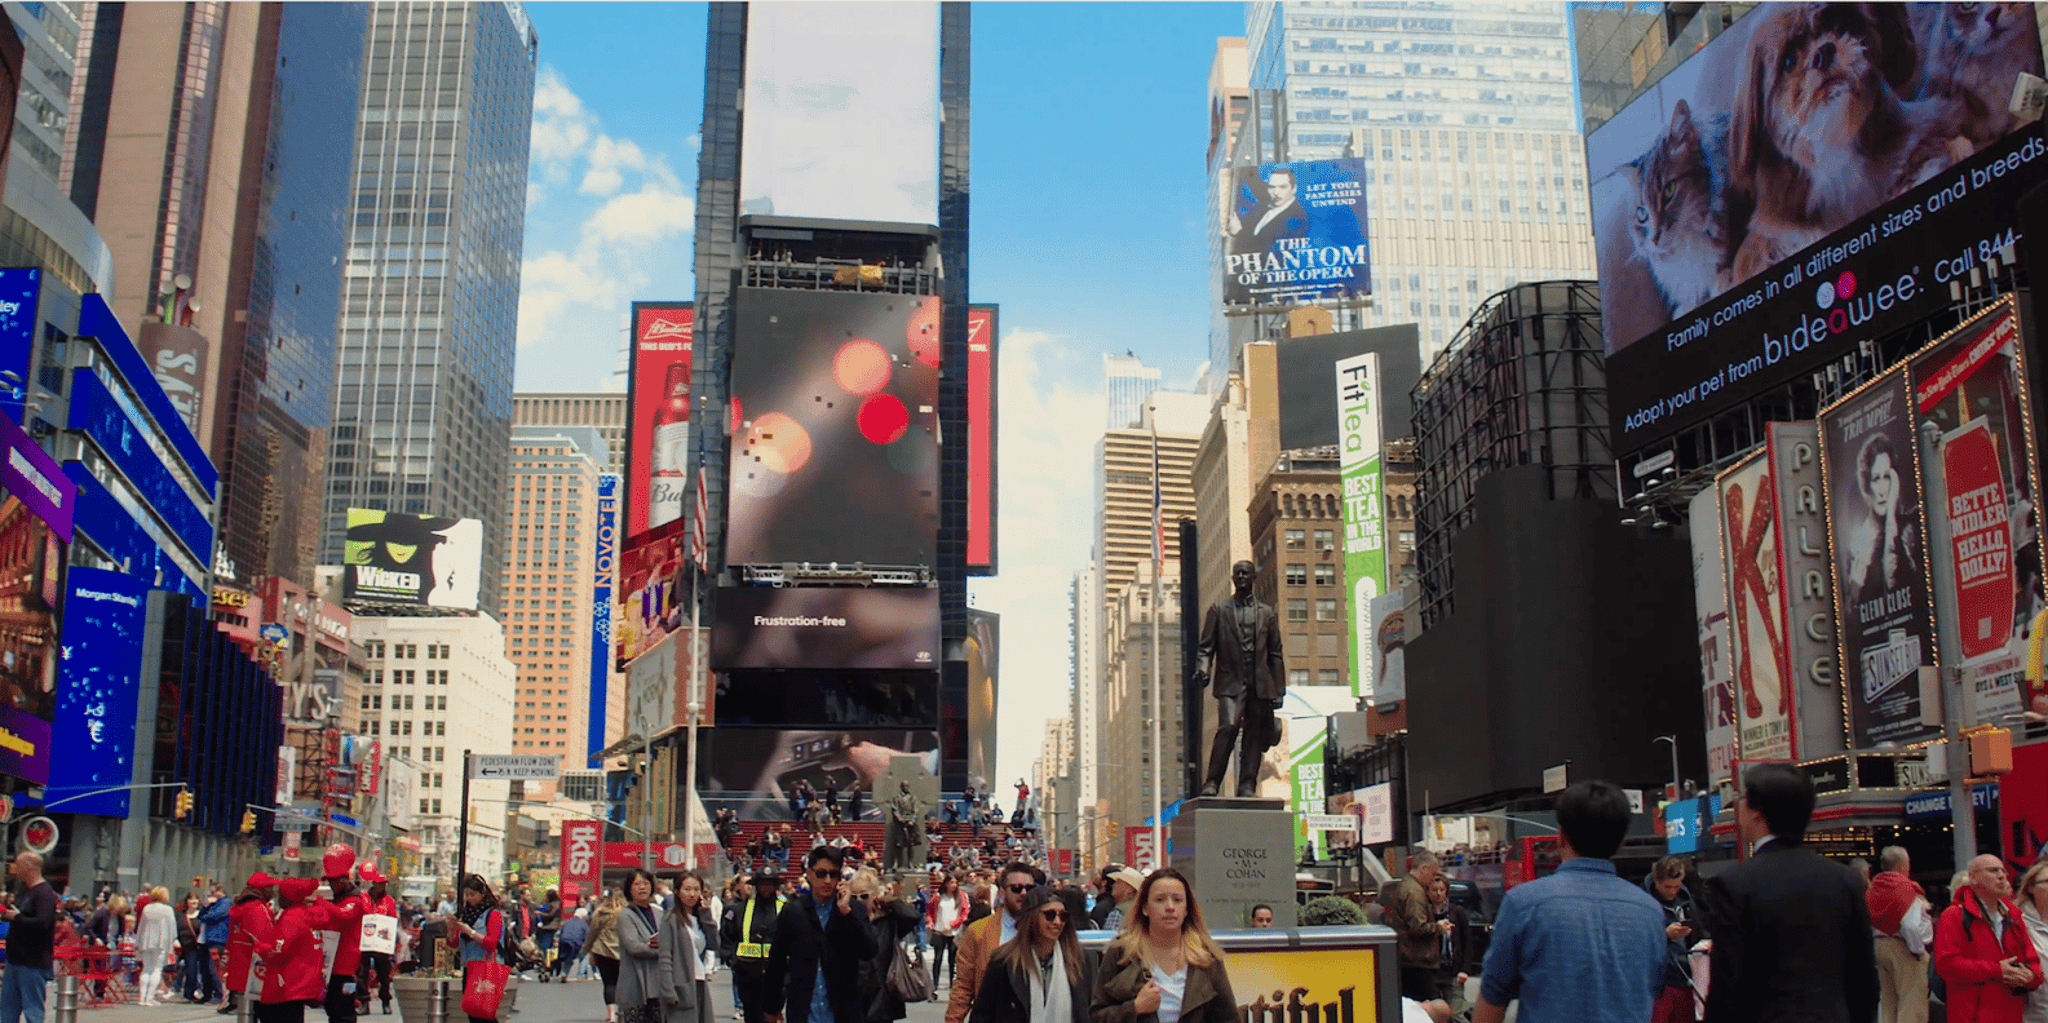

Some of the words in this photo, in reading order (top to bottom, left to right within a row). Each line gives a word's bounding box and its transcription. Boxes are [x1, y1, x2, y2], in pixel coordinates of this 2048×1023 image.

[1305, 189, 1362, 200] FANTASIES
[1307, 184, 1327, 192] LET
[1331, 181, 1360, 190] YOUR
[1312, 198, 1356, 207] UNWIND
[1276, 237, 1311, 251] THE
[1667, 317, 1710, 352] Family
[1713, 289, 1763, 327] comes
[1764, 280, 1780, 300] in
[1783, 265, 1802, 289] all
[1805, 223, 1878, 277] different
[1881, 203, 1923, 238] sizes
[1927, 174, 1967, 213] and
[1971, 136, 2048, 190] breeds.
[1225, 244, 1366, 275] PHANTOM
[1238, 272, 1260, 285] OF
[1263, 270, 1297, 283] THE
[1300, 266, 1355, 280] OPERA
[1624, 397, 1665, 433] Adopt
[1667, 384, 1697, 415] your
[1699, 368, 1725, 400] pet
[1728, 354, 1763, 383] from
[1934, 247, 1974, 283] Call
[1342, 364, 1370, 453] FitTea
[1344, 472, 1378, 497] BEST
[1345, 494, 1380, 523] TEA
[1951, 482, 2000, 516] BETTE
[1359, 519, 1381, 537] THE
[1951, 502, 2008, 538] MIDLER
[594, 495, 616, 588] NOVOTEL
[1956, 529, 2007, 560] HELLO,
[1791, 442, 1832, 687] PALACE
[1959, 550, 2008, 583] DOLLY!
[356, 565, 420, 589] WICKED
[1860, 596, 1886, 623] GLENN
[1887, 586, 1912, 613] CLOSE
[753, 615, 846, 627] Frustration-free
[531, 768, 555, 776] MOVING
[1298, 763, 1324, 779] BEST
[1298, 778, 1324, 800] TEA
[1906, 797, 1947, 814] CHANGE
[570, 826, 596, 875] tkts
[1222, 847, 1268, 859] GEORGE
[1225, 868, 1266, 879] COHAN
